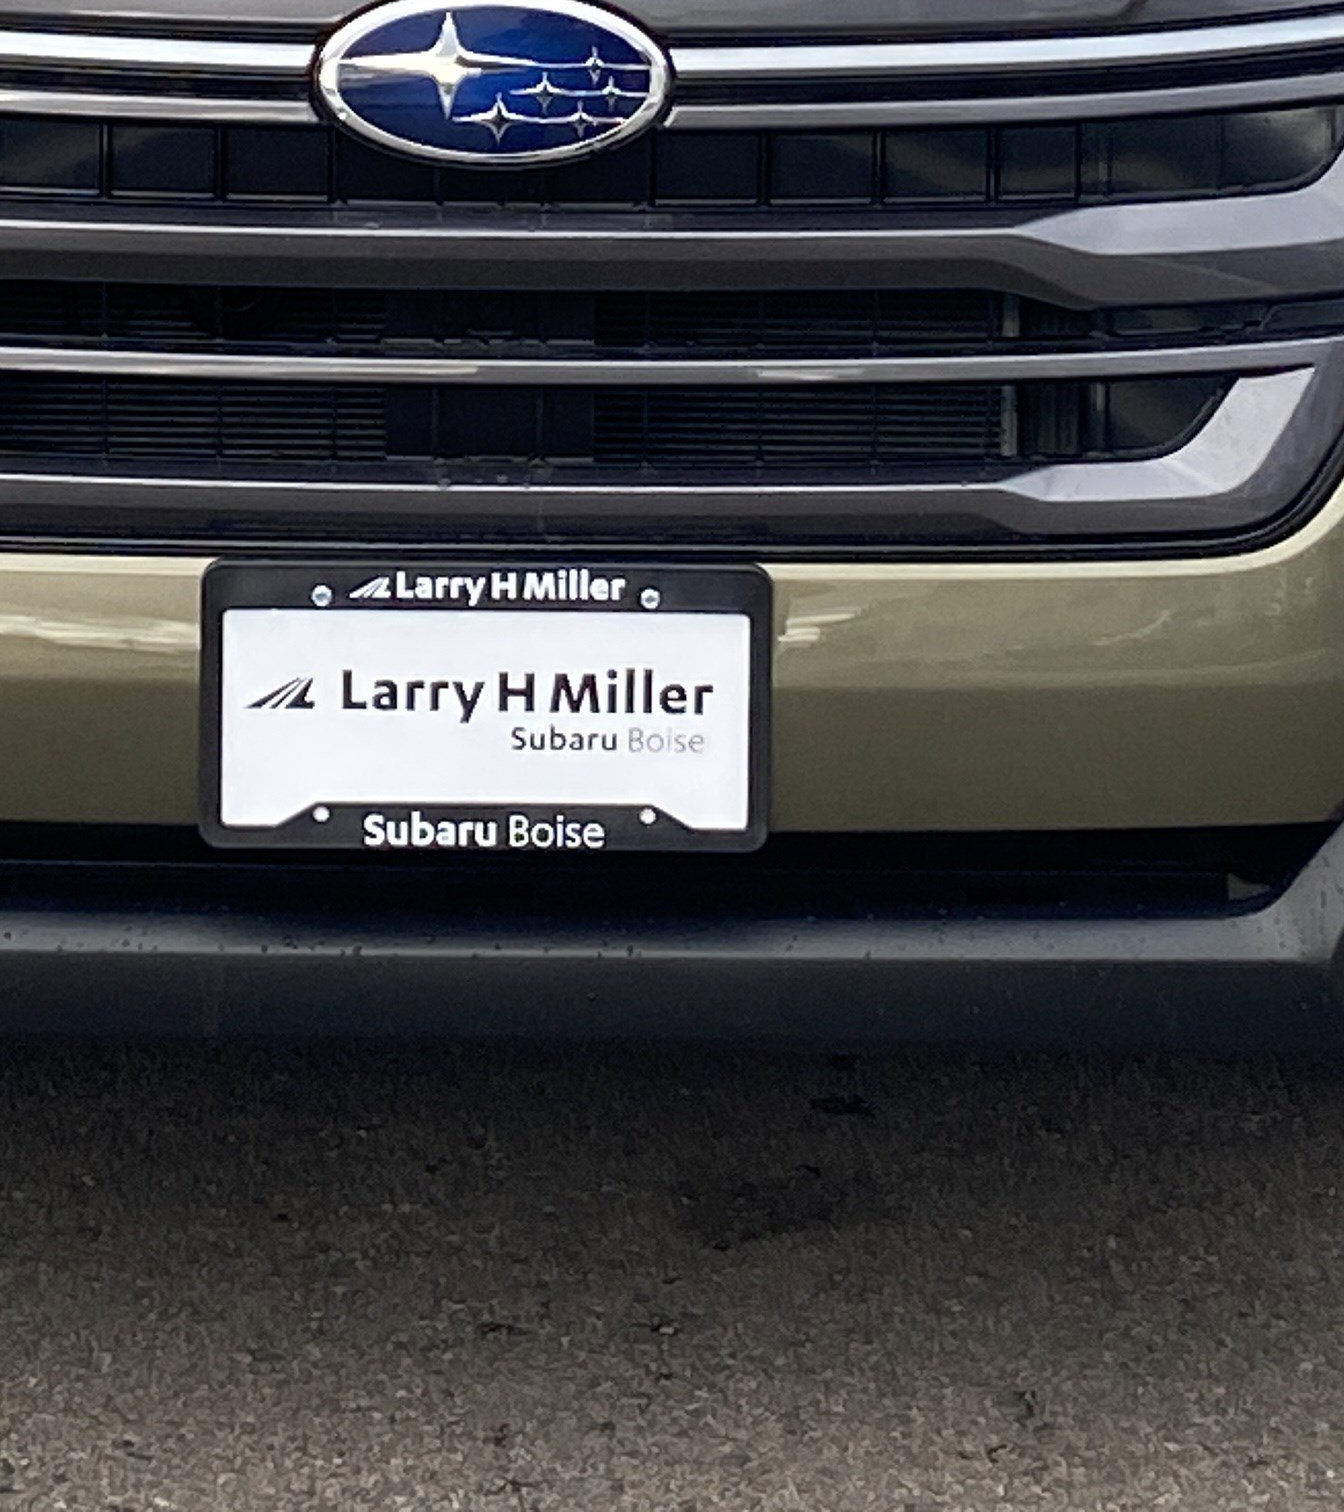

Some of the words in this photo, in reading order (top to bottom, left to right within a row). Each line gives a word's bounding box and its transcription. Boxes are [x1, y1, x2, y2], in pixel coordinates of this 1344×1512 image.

[396, 570, 486, 607] Larry
[490, 572, 517, 600] H
[523, 569, 626, 601] Miller
[341, 669, 485, 724] Larry
[497, 671, 536, 713] H
[549, 668, 714, 715] Miller
[511, 725, 618, 752] Subaru
[627, 726, 706, 754] Boise
[363, 811, 498, 847] Subaru
[508, 814, 606, 849] Boise
